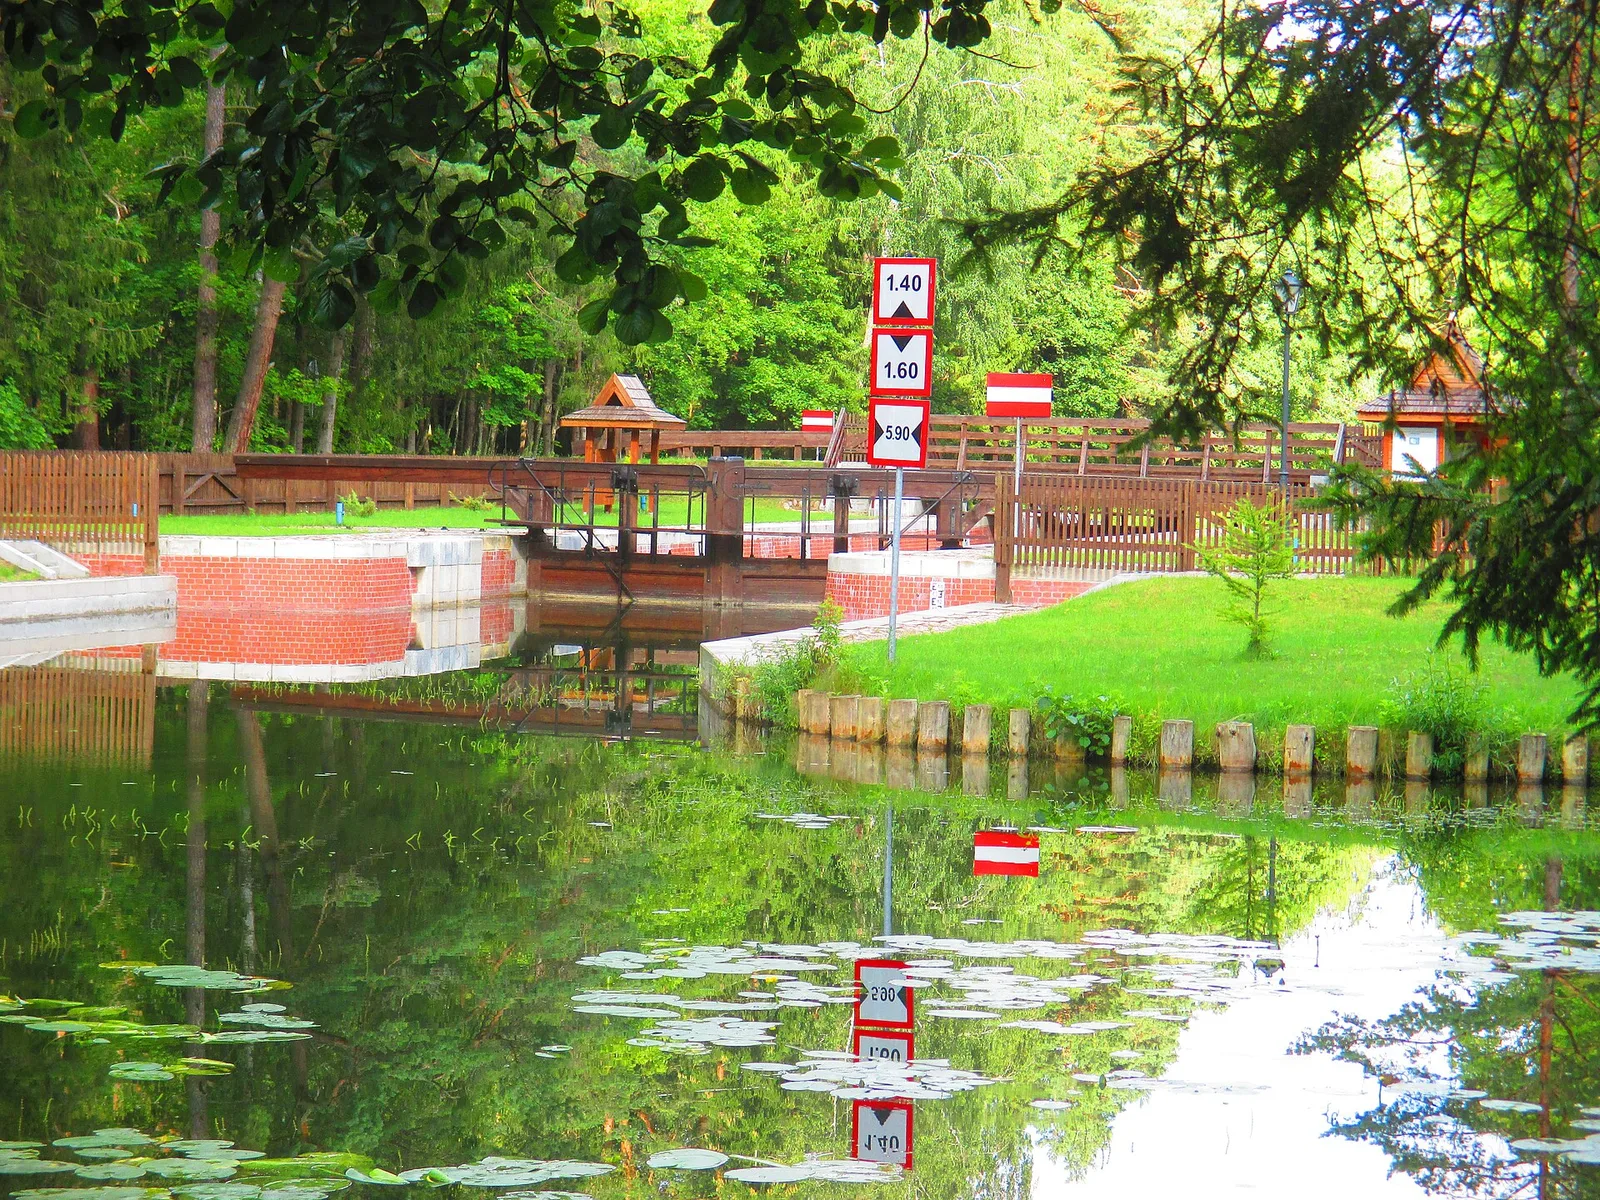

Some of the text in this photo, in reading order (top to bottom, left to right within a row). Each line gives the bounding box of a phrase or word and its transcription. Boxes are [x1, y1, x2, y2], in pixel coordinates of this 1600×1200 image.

[886, 274, 922, 292] 1.40
[884, 361, 918, 379] 1.60
[885, 425, 910, 441] 5.90
